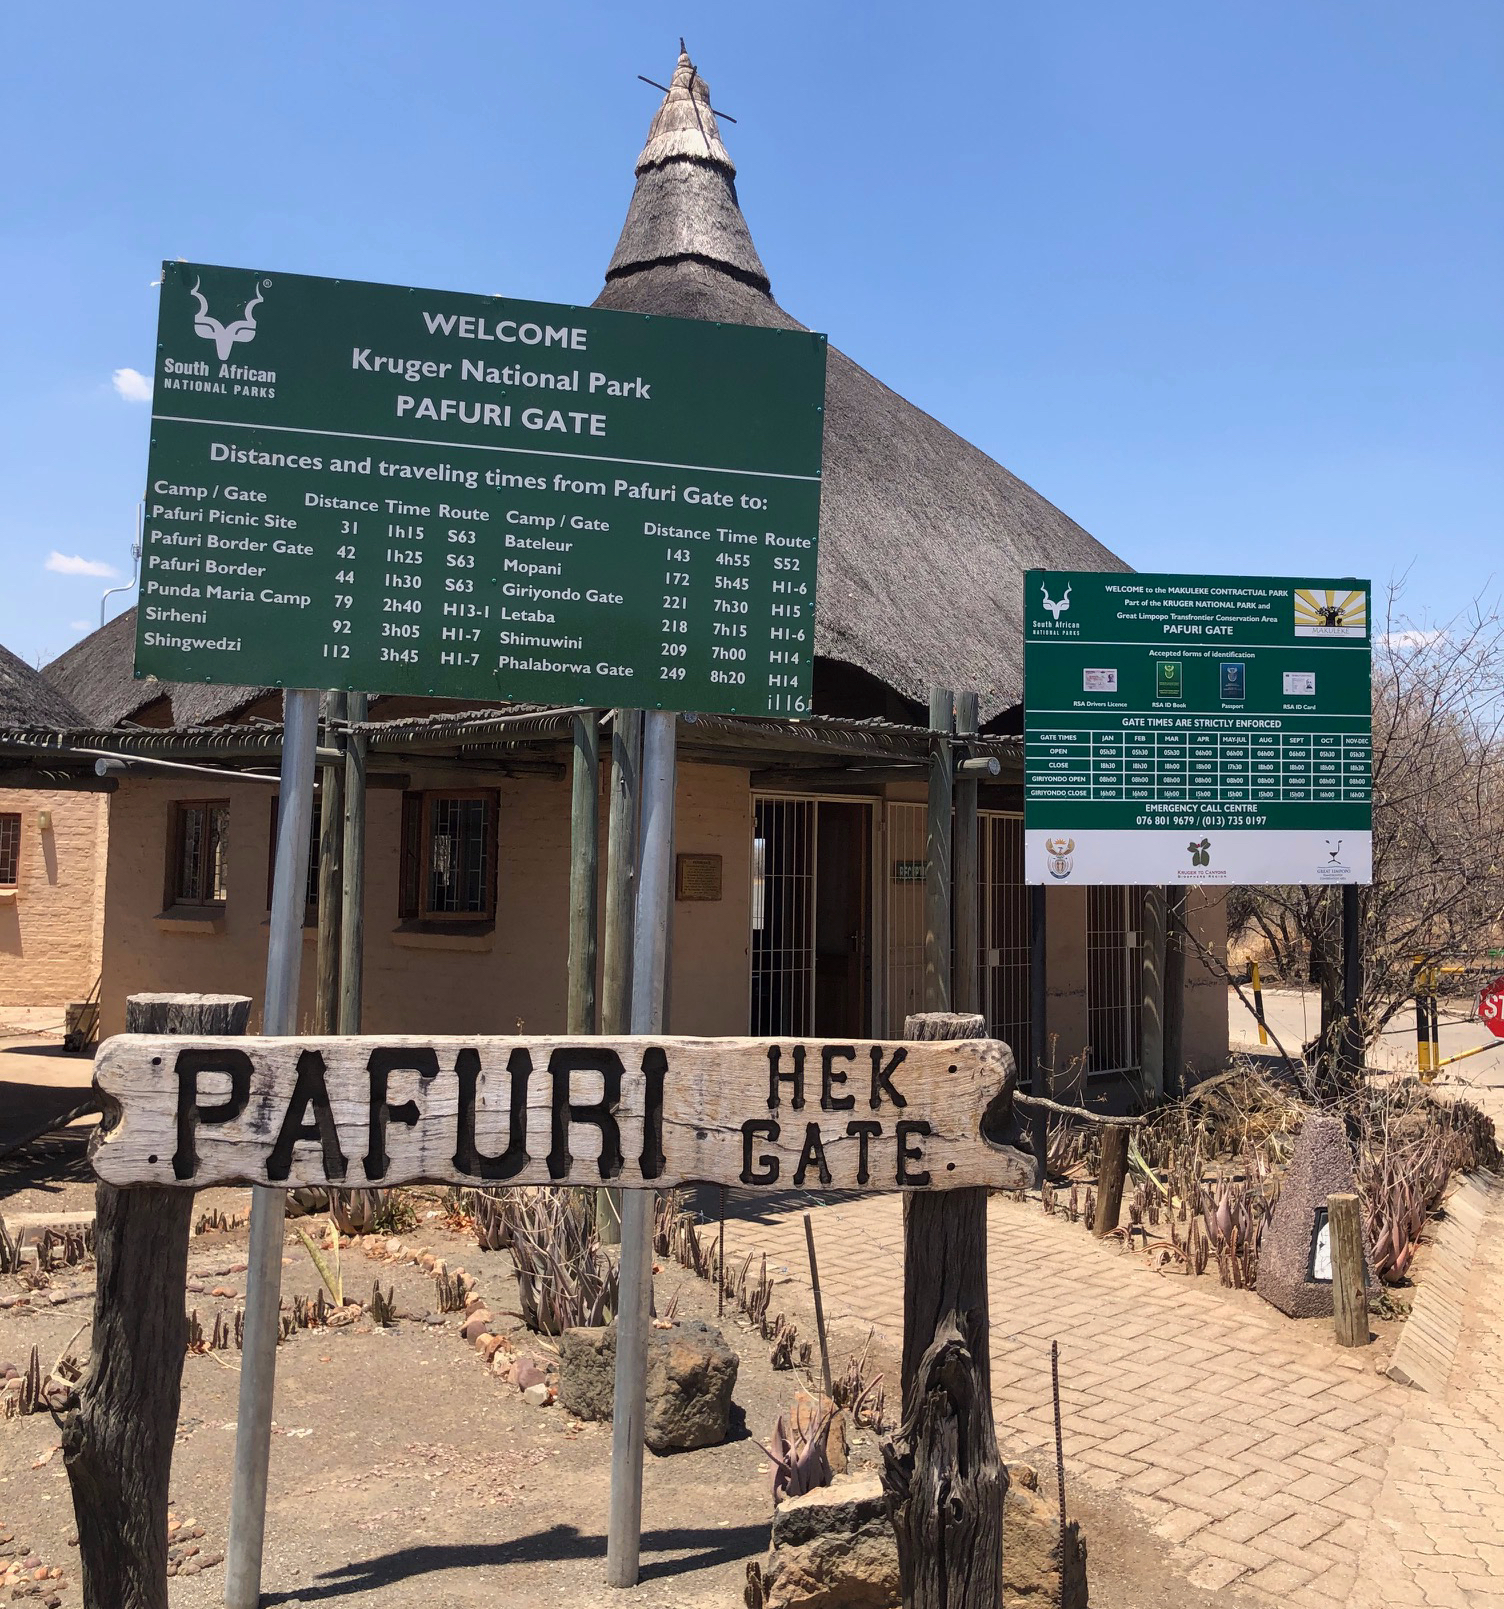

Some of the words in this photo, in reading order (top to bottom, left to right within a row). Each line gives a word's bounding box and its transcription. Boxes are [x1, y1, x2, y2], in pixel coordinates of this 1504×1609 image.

[422, 311, 587, 351] WELCOME
[164, 357, 209, 377] South
[218, 363, 276, 383] African
[352, 347, 453, 382] Kruger
[461, 358, 579, 392] National
[589, 371, 651, 400] Park
[164, 378, 228, 394] NATIONAL
[233, 384, 275, 399] PARKS
[396, 395, 511, 427] PAFURI
[521, 407, 607, 437] GATE
[210, 442, 323, 470] Distances
[329, 456, 372, 475] and
[378, 460, 479, 489] traveling
[484, 468, 547, 490] times
[553, 474, 606, 496] from
[614, 479, 676, 502] Pafuri
[683, 486, 734, 507] Gate
[739, 493, 768, 511] to:
[154, 480, 208, 501] Camp
[223, 486, 267, 503] Gate
[304, 492, 379, 512] Distance
[384, 499, 431, 517] Time
[438, 503, 490, 521] Route
[152, 504, 203, 522] Pafuri
[209, 509, 259, 526] Picnic
[264, 514, 297, 529] Site
[340, 520, 358, 535] 31
[388, 524, 424, 540] 1h15
[447, 529, 476, 544] S63
[506, 510, 556, 531] Camp
[570, 515, 610, 532] Gate
[644, 522, 711, 541] Distance
[716, 528, 758, 545] Time
[765, 532, 811, 549] Route
[150, 530, 202, 547] Pafuri
[207, 534, 268, 552] Border
[272, 539, 314, 556] Gate
[336, 545, 356, 559] 42
[386, 548, 423, 565] 1h25
[446, 553, 475, 569] S63
[505, 534, 573, 552] Bateleur
[666, 548, 690, 562] 143
[715, 552, 750, 567] 4h55
[773, 557, 800, 571] S52
[149, 555, 200, 572] Pafuri
[205, 559, 267, 577] Border
[335, 570, 355, 584] 44
[385, 573, 422, 589] 1h30
[445, 578, 474, 593] S63
[503, 558, 562, 577] Mopani
[666, 572, 690, 586] 172
[714, 575, 749, 591] 5h45
[147, 580, 202, 598] Punda
[206, 585, 255, 602] Maria
[260, 589, 311, 609] Camp
[334, 594, 354, 609] 79
[382, 598, 422, 614] 2h40
[502, 582, 581, 602] Giriyondo
[585, 589, 624, 604] Gate
[662, 595, 687, 610] 221
[713, 599, 749, 614] 7h30
[1211, 588, 1267, 596] CONTRACTUAL
[145, 606, 207, 624] Sirheni
[332, 619, 352, 634] 92
[381, 623, 420, 638] 3h05
[501, 606, 556, 624] Letaba
[661, 619, 688, 633] 218
[712, 622, 747, 637] 7h15
[1139, 613, 1169, 621] Limpopo
[1170, 613, 1213, 621] Transfrontier
[1163, 625, 1202, 635] PAFURI
[1206, 626, 1233, 634] GATE
[144, 631, 242, 652] Shingwedzi
[323, 644, 350, 659] 112
[380, 647, 419, 663] 3h45
[500, 631, 583, 650] Shimuwini
[661, 642, 687, 657] 209
[711, 646, 747, 661] 7h00
[499, 655, 592, 674] Phalaborwa
[596, 662, 634, 677] Gate
[660, 666, 686, 681] 249
[710, 670, 746, 685] 8h20
[1122, 718, 1145, 726] GATE
[1148, 718, 1173, 727] TIMES
[1175, 719, 1192, 727] ARE
[1194, 719, 1234, 729] STRICTLY
[1236, 720, 1281, 728] ENFORCED
[1137, 816, 1152, 825] 076
[1155, 816, 1170, 824] 801
[1173, 816, 1194, 825] 9679
[1202, 816, 1225, 827] (013)
[1228, 817, 1243, 825] 735
[1246, 817, 1266, 825] 0197
[1145, 803, 1198, 813] EMERGENCY
[765, 1044, 909, 1110] HEK
[171, 1045, 669, 1182] PAFURI
[741, 1119, 933, 1186] GATE
